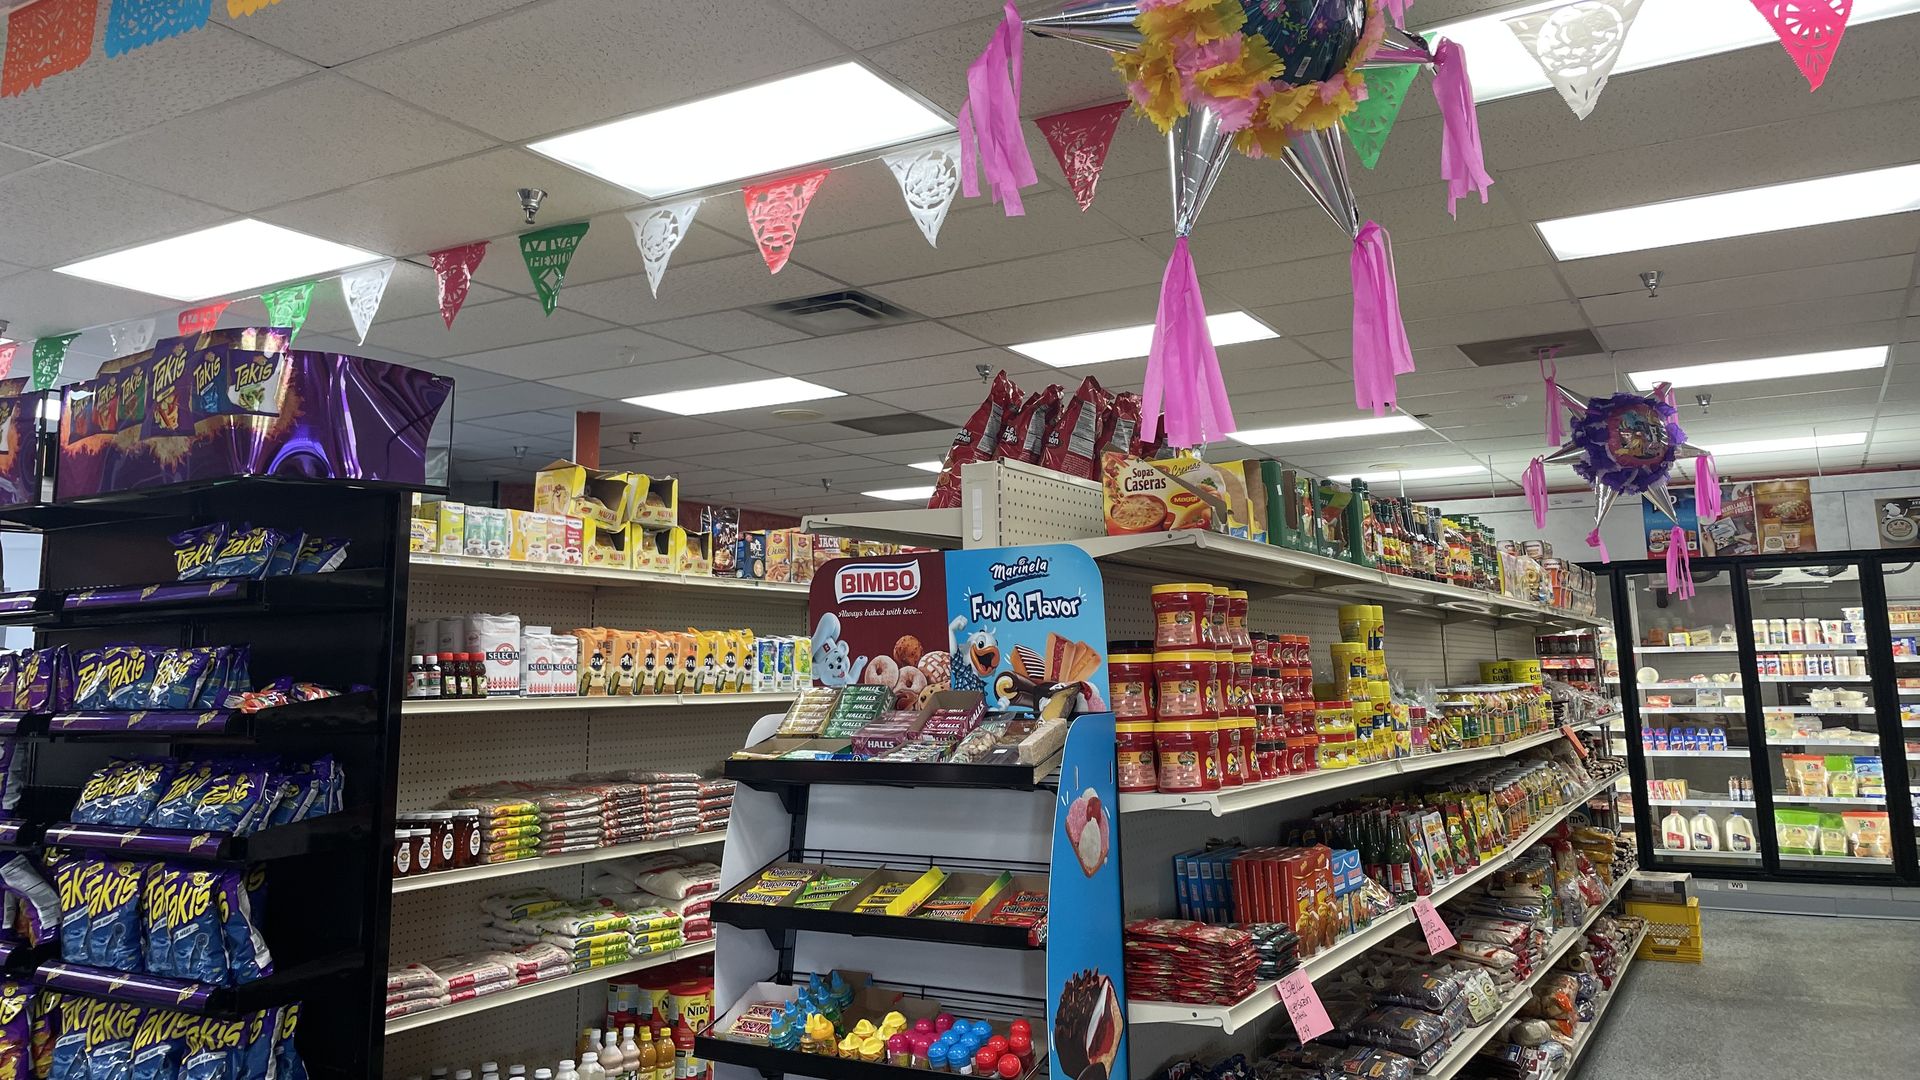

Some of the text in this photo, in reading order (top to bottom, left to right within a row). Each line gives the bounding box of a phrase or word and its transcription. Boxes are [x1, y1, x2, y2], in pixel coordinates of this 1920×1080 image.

[121, 369, 143, 405] Takis
[152, 351, 188, 401] Takis
[193, 356, 221, 395] Takis
[235, 360, 273, 391] Takis
[1124, 477, 1167, 493] Caseras
[1132, 467, 1154, 480] Sopas
[1174, 495, 1199, 504] Maggi
[818, 536, 839, 548] JACK
[841, 570, 914, 594] BIMBO
[992, 557, 1049, 580] Marinela
[838, 608, 863, 619] Always
[864, 607, 885, 618] baked
[886, 606, 902, 617] with
[1008, 592, 1022, 621] &
[1027, 590, 1081, 621] Flavor
[488, 652, 519, 660] SELECTA
[106, 654, 146, 700] Takis
[969, 700, 985, 729] HALLS
[867, 740, 895, 749] HALLS
[58, 867, 87, 912] Tak
[86, 870, 141, 919] Takis
[165, 879, 214, 930] Takis
[86, 999, 141, 1052] Takis
[687, 1005, 709, 1017] NIDO
